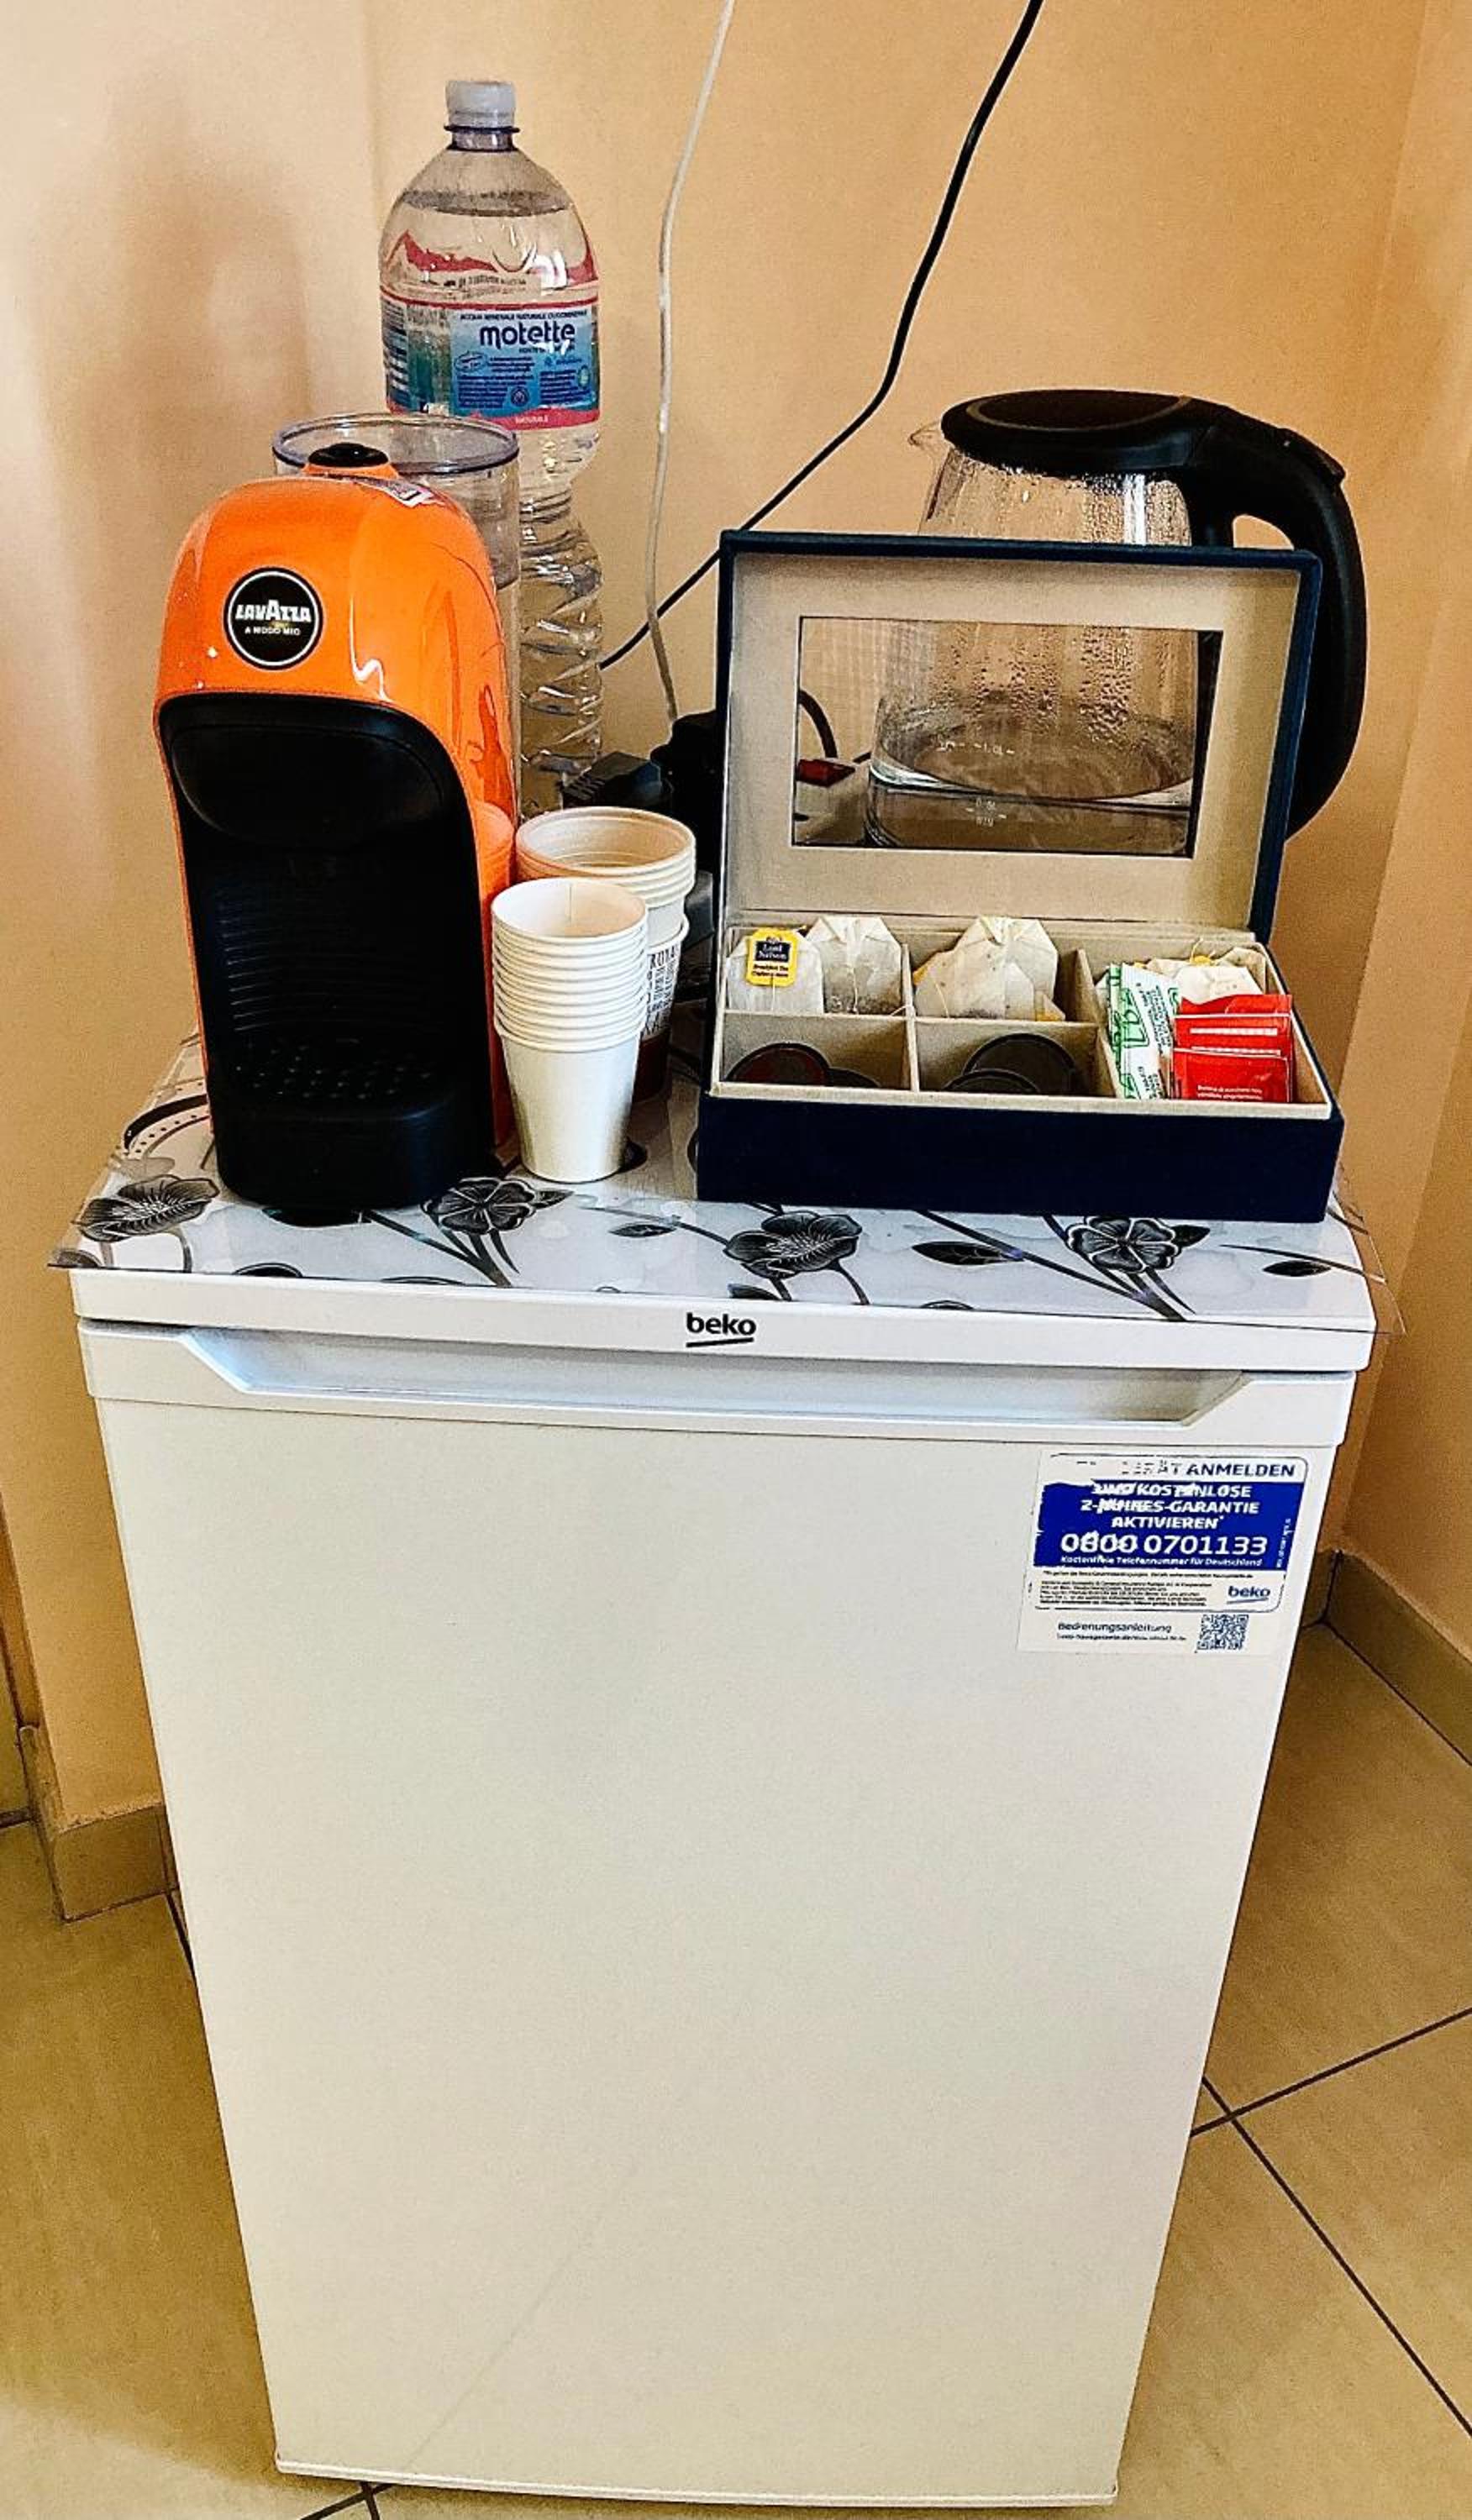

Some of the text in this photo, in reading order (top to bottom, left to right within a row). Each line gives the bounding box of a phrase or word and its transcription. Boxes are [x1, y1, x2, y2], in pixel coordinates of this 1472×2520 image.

[480, 321, 576, 349] motette
[235, 599, 312, 622] LAVAZZA
[244, 626, 251, 634] A
[283, 627, 301, 636] MIO
[686, 1312, 756, 1336] beko
[1186, 1463, 1295, 1477] ANMELDEN
[1060, 1532, 1138, 1553] 0800
[1143, 1534, 1268, 1556] 0701133
[1117, 1557, 1187, 1566] Telefonnummer
[1190, 1557, 1202, 1566] für
[1205, 1557, 1263, 1567] Deutschland
[1228, 1585, 1270, 1598] beko
[1058, 1622, 1172, 1633] Bedienungsanleitung
